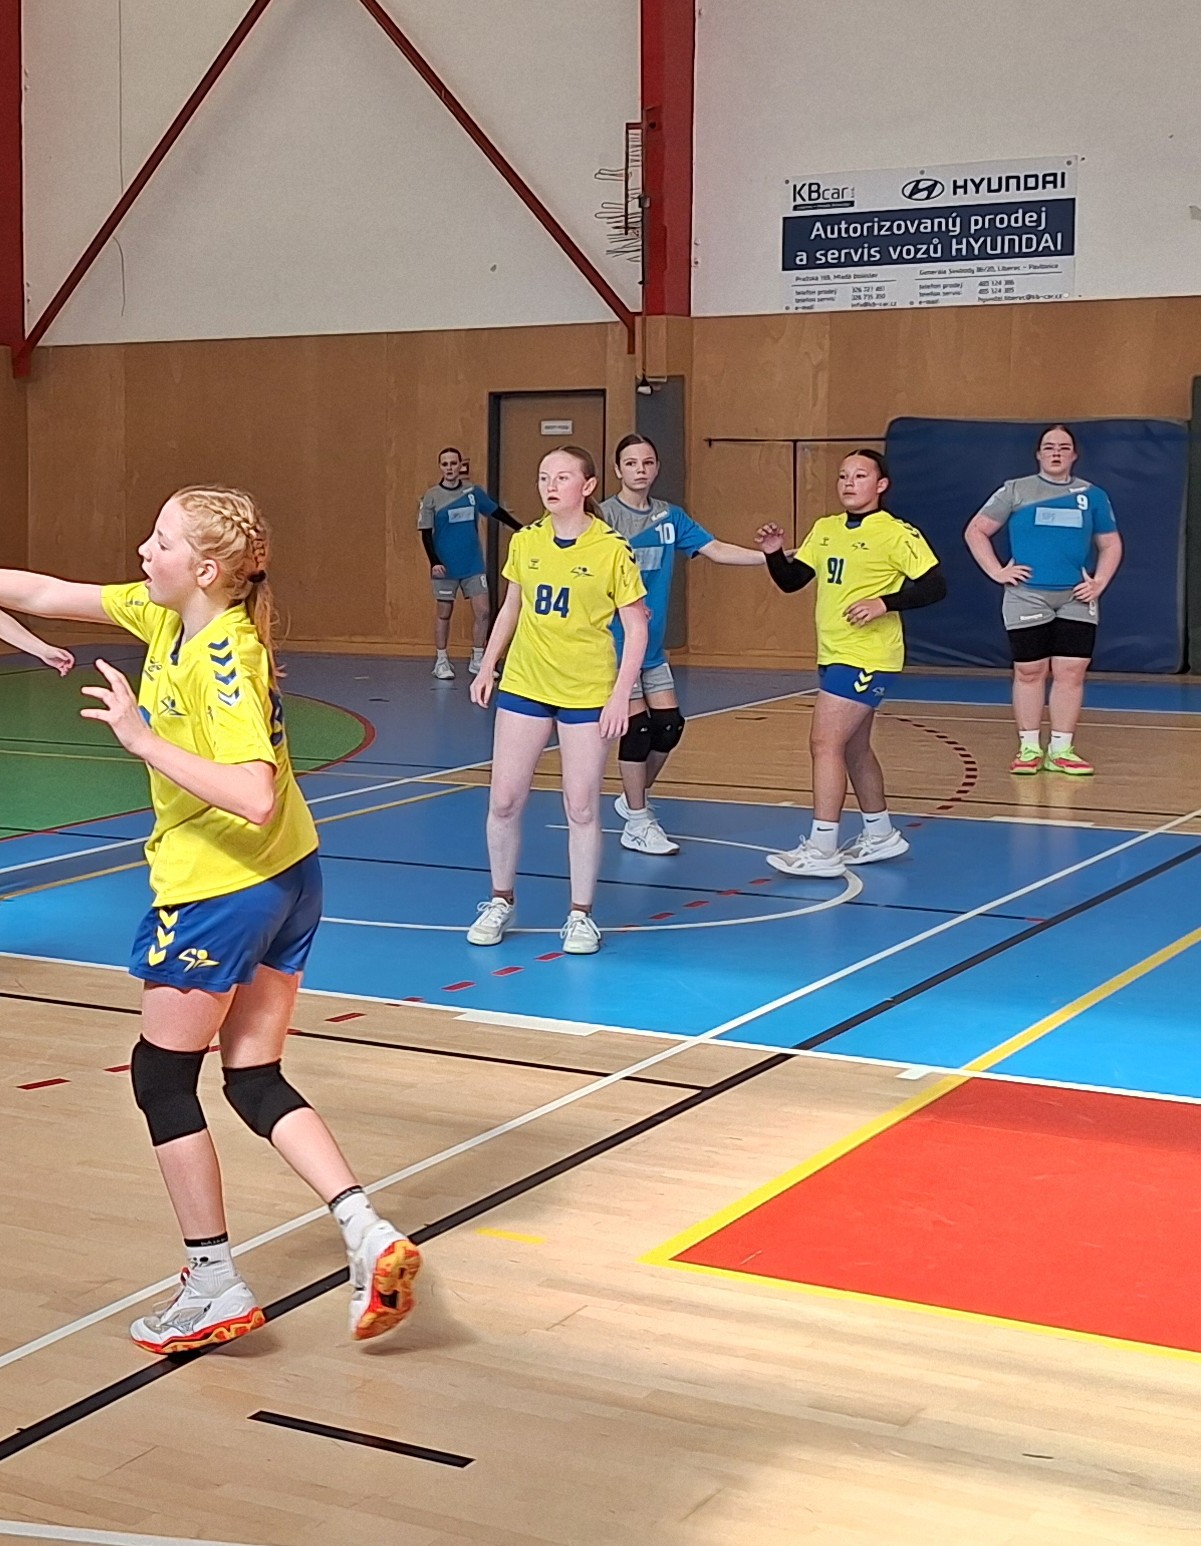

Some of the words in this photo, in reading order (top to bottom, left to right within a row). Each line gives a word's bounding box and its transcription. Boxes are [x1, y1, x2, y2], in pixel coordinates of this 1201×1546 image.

[793, 182, 849, 202] KBcar
[952, 171, 1066, 196] HYUNDAI
[810, 212, 961, 240] Autorizovaný
[970, 206, 1047, 234] prodej
[795, 251, 807, 265] a
[815, 244, 881, 264] servis
[888, 238, 942, 260] vozů
[951, 232, 1063, 257] HYUNDAI
[1077, 494, 1088, 510] 9
[655, 522, 676, 544] 10
[827, 557, 845, 585] 91
[535, 584, 571, 618] 84
